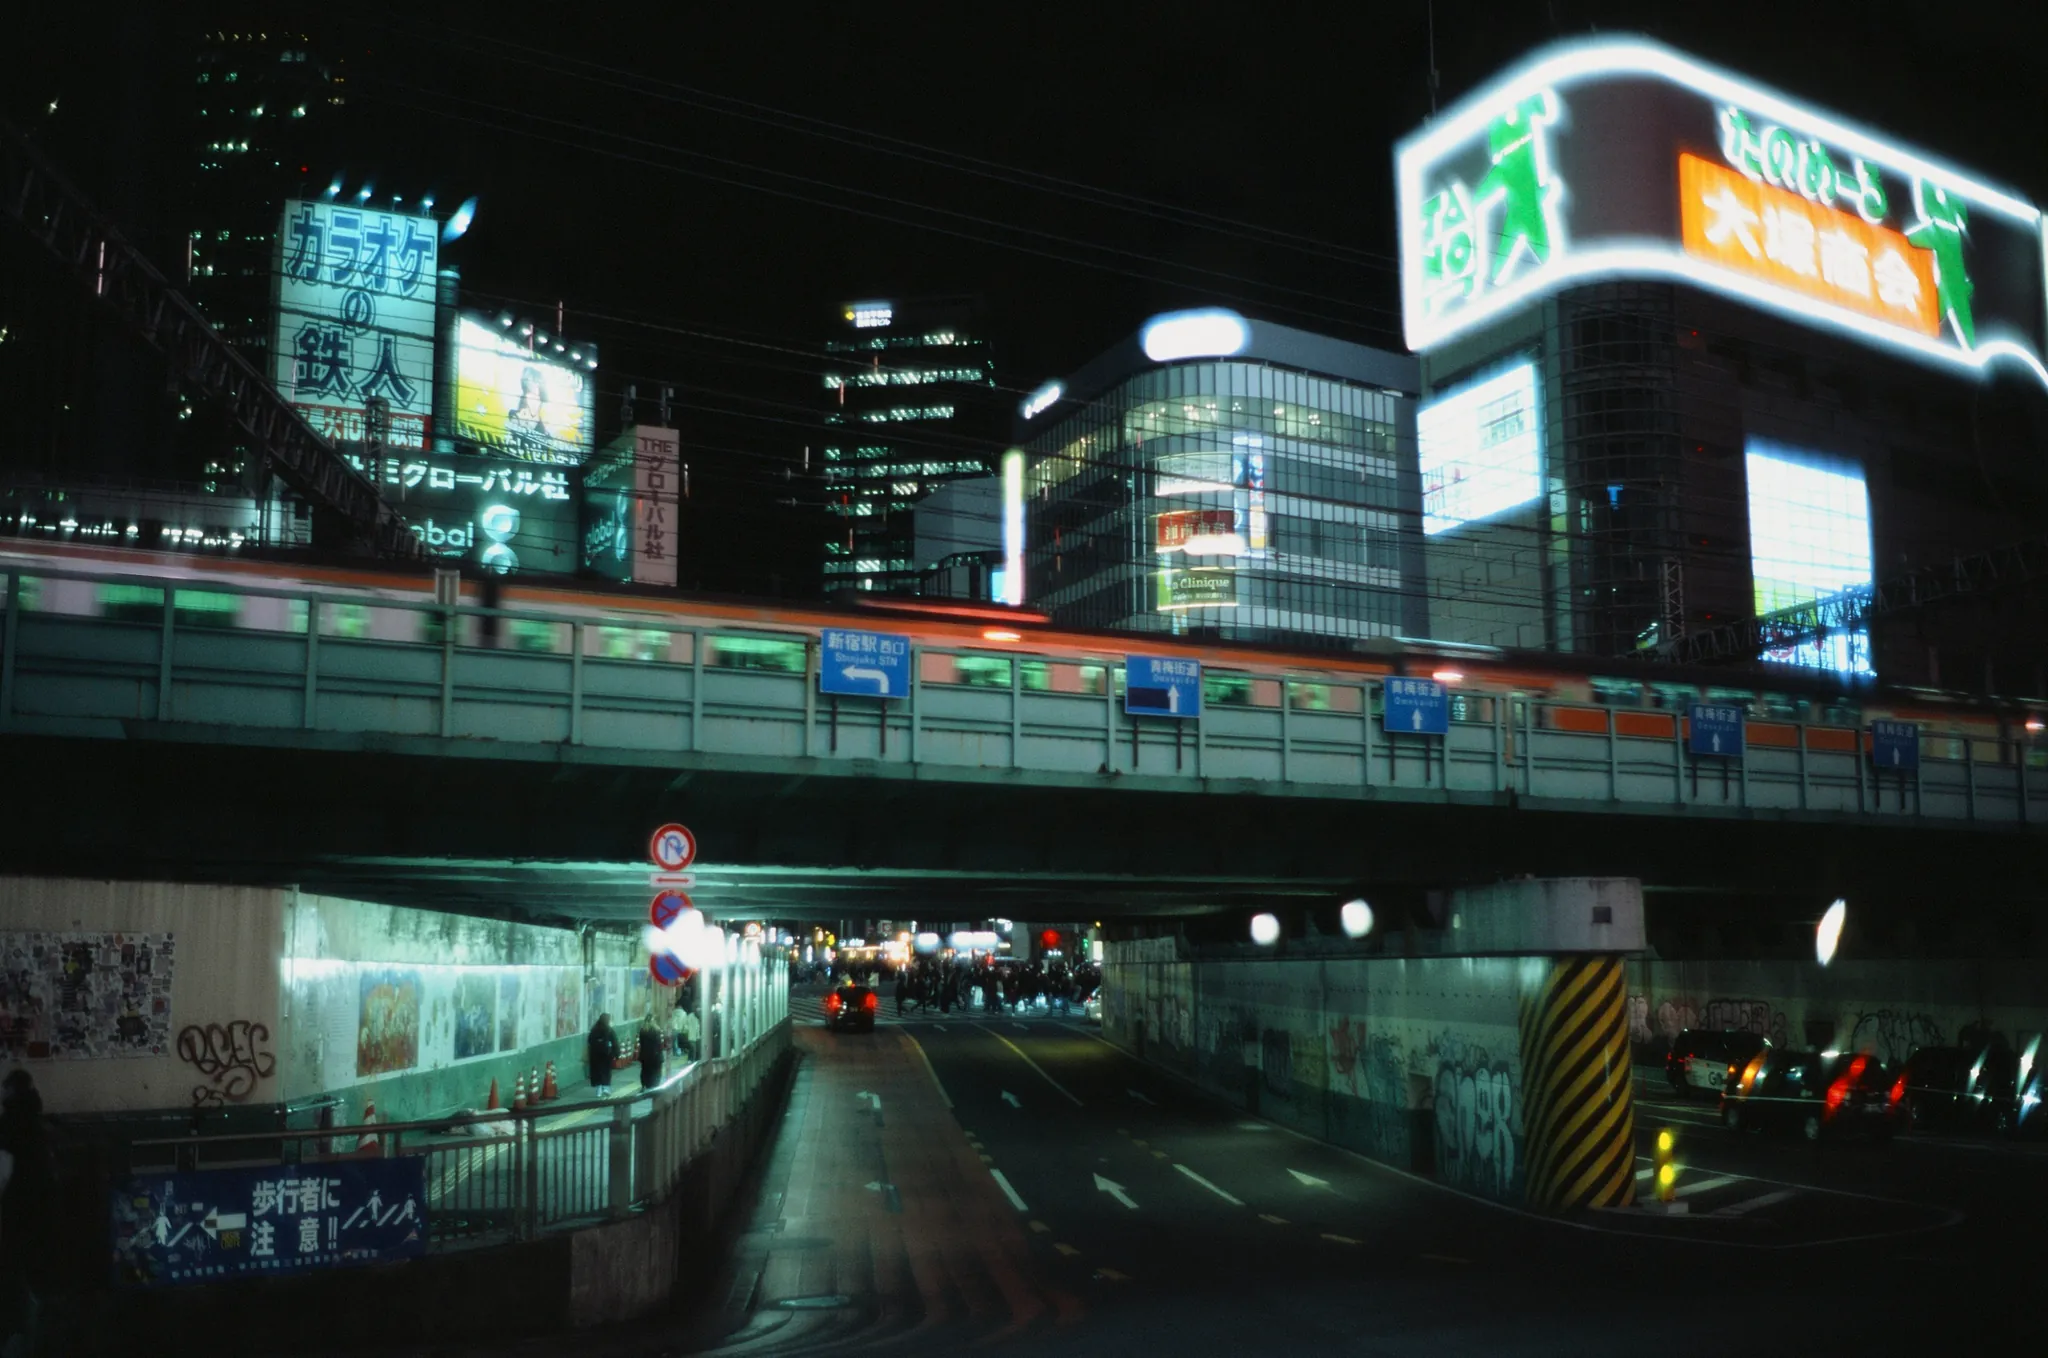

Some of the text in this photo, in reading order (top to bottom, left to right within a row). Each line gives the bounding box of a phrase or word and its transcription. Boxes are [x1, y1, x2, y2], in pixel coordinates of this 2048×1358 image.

[286, 203, 436, 298] カラオケ
[340, 287, 377, 338] の
[293, 321, 418, 403] 鉄人
[640, 436, 673, 453] THE
[644, 455, 666, 560] グローバル社
[1180, 576, 1230, 590] Clinique
[252, 1177, 342, 1217] 歩行者に
